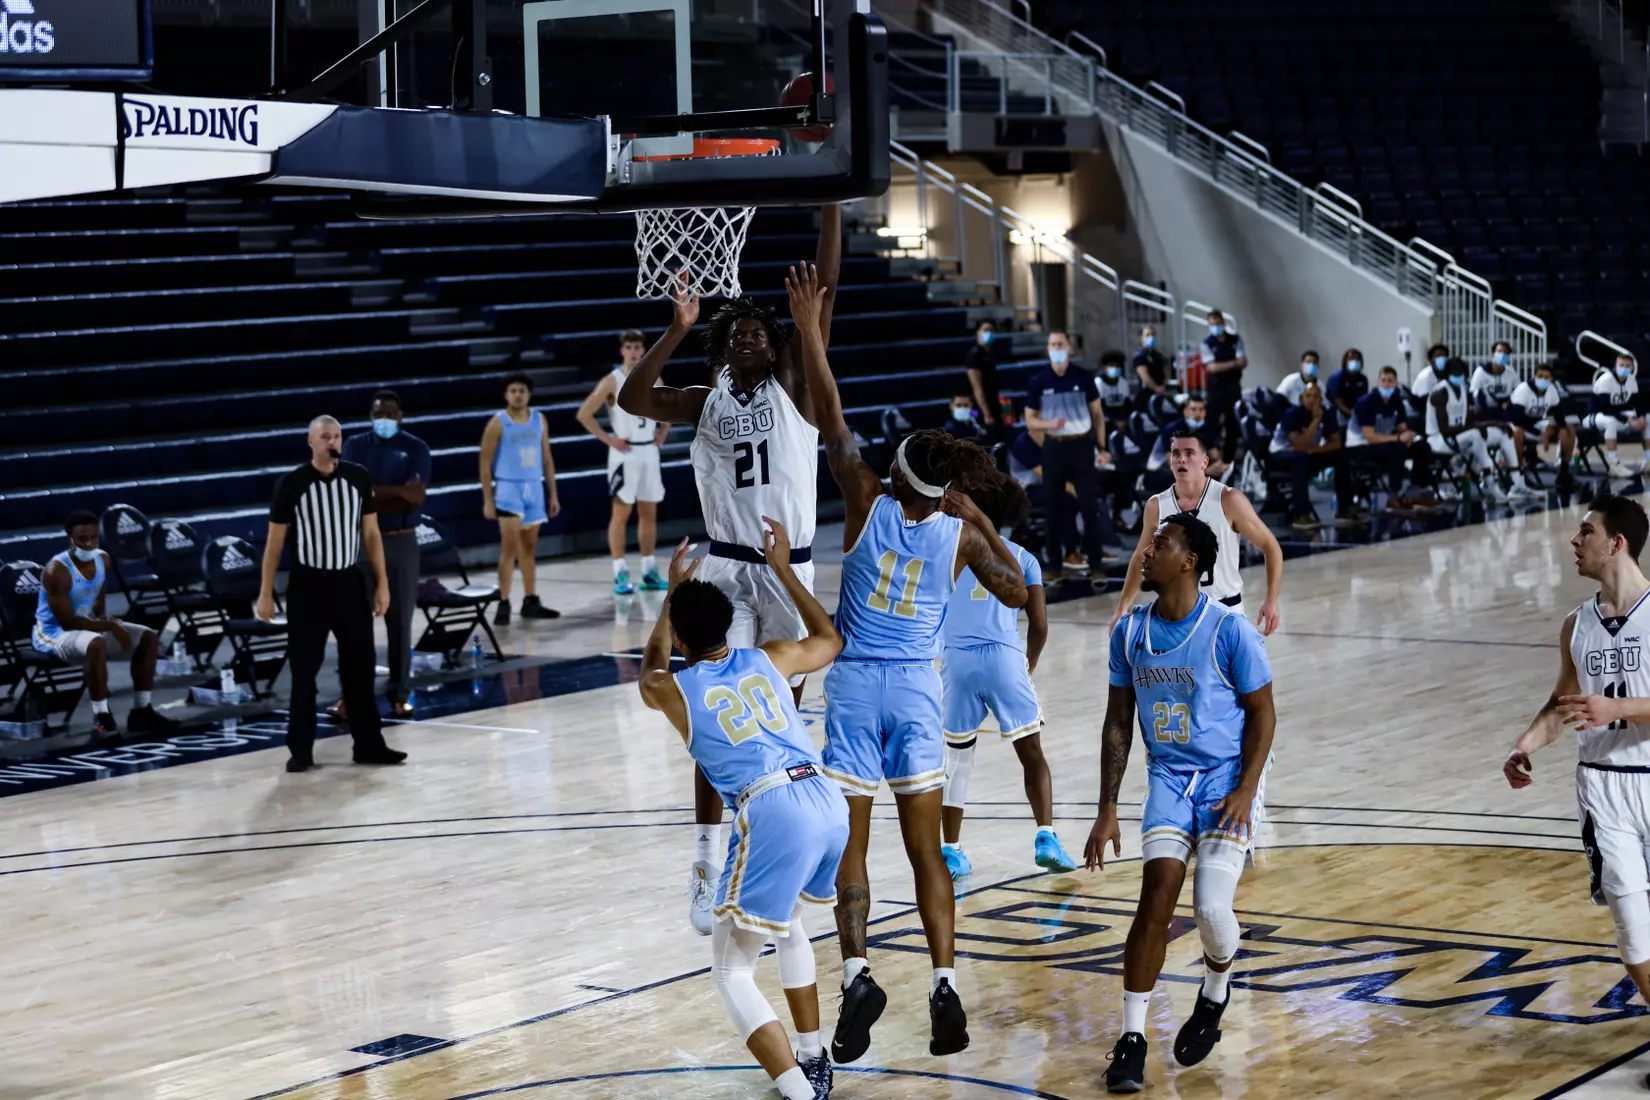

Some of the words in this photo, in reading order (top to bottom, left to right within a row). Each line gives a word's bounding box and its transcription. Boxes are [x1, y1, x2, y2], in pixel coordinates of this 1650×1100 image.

[718, 407, 774, 440] CBU
[733, 438, 770, 489] 21
[165, 537, 194, 550] adidas
[221, 558, 254, 571] adidas
[866, 549, 925, 619] 11
[1585, 645, 1641, 677] CBU
[1133, 665, 1196, 694] HAWKS
[703, 672, 788, 747] 20
[1153, 701, 1191, 744] 23
